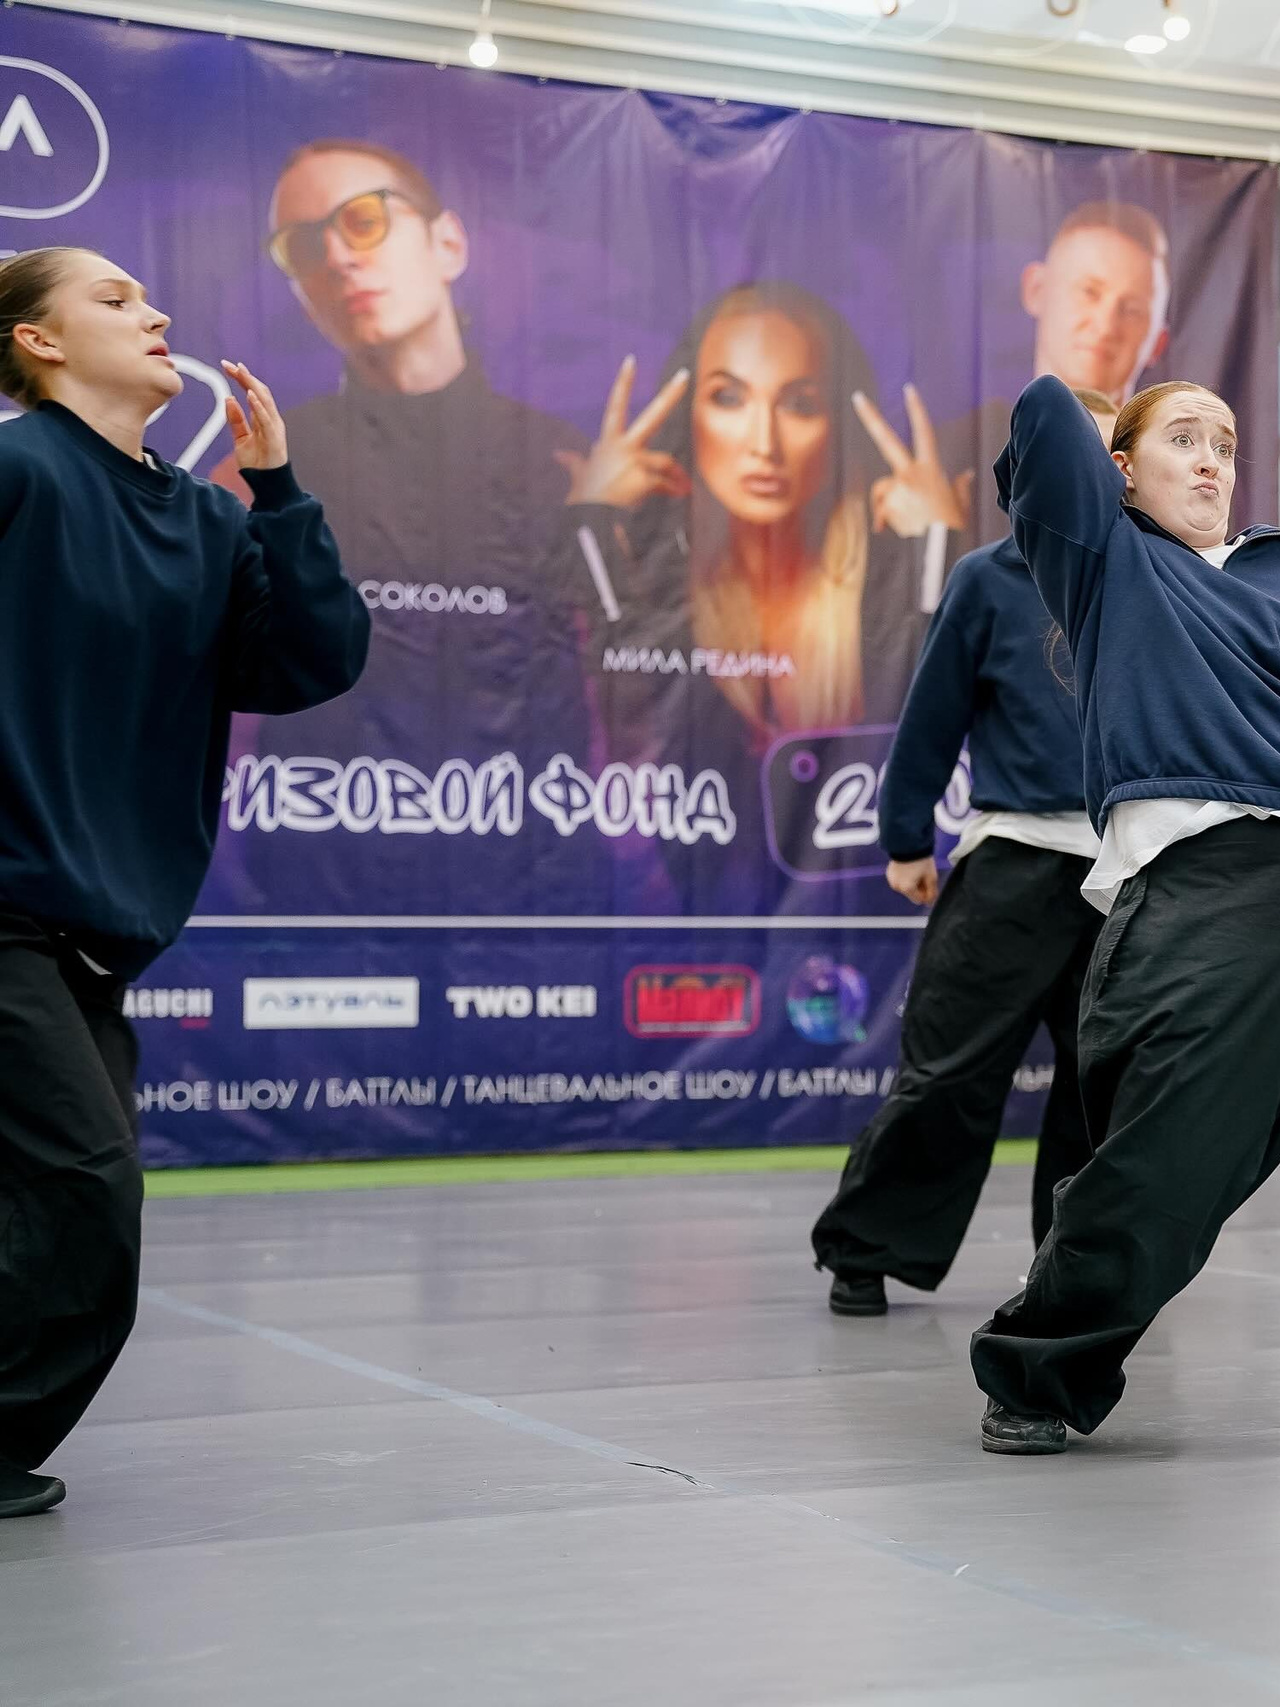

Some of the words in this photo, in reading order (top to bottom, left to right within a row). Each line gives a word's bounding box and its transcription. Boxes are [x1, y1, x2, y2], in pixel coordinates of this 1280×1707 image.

[357, 579, 508, 615] СОКОЛОВ
[602, 647, 690, 675] МИЛА
[222, 751, 524, 836] ИЗОВОЙ
[529, 753, 736, 845] ФОНД
[446, 985, 532, 1019] TWO
[218, 1079, 298, 1111] ШОУ
[325, 1076, 436, 1108] БАТТЛЫ
[461, 1070, 682, 1105] ТАНЦЕВАЛЬНОЕ
[685, 1069, 758, 1100] ШОУ
